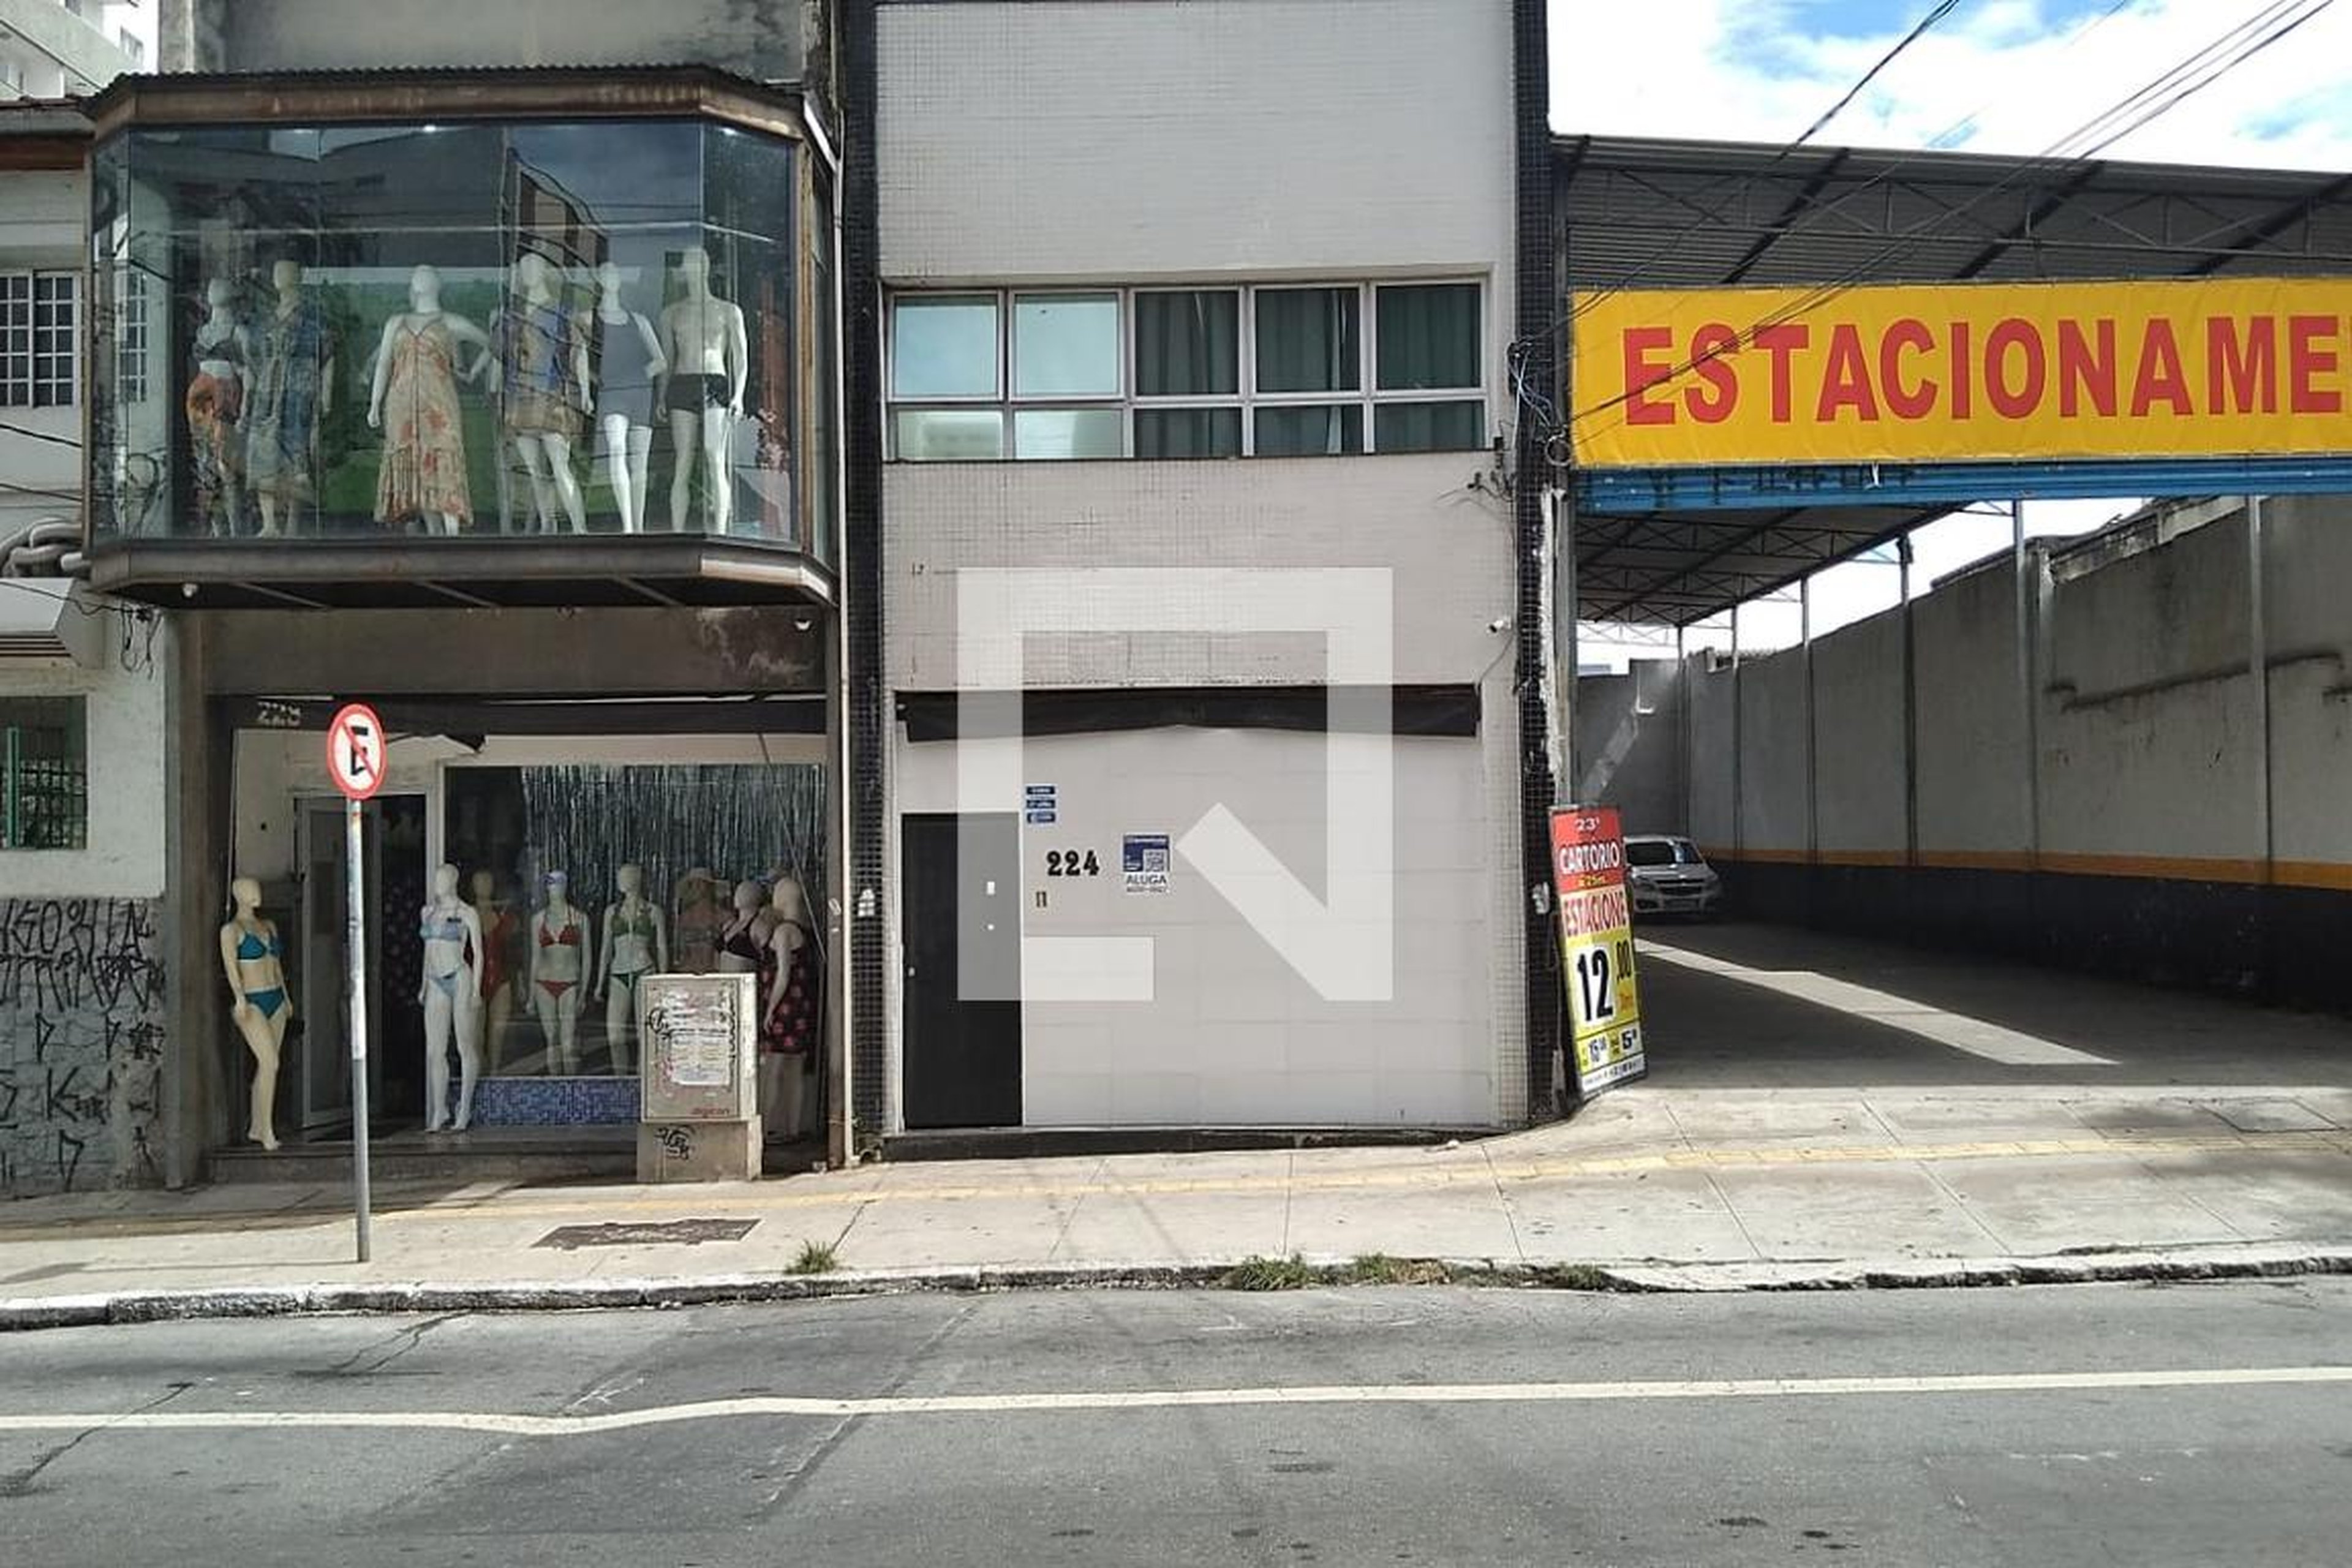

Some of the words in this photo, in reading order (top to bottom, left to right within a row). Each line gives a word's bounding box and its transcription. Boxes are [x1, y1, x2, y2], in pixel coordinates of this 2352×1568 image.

[1623, 315, 2352, 426] ESTACIONAME
[1046, 850, 1099, 876] 224
[1126, 875, 1167, 884] ALUGA
[1577, 948, 1614, 1022] 12
